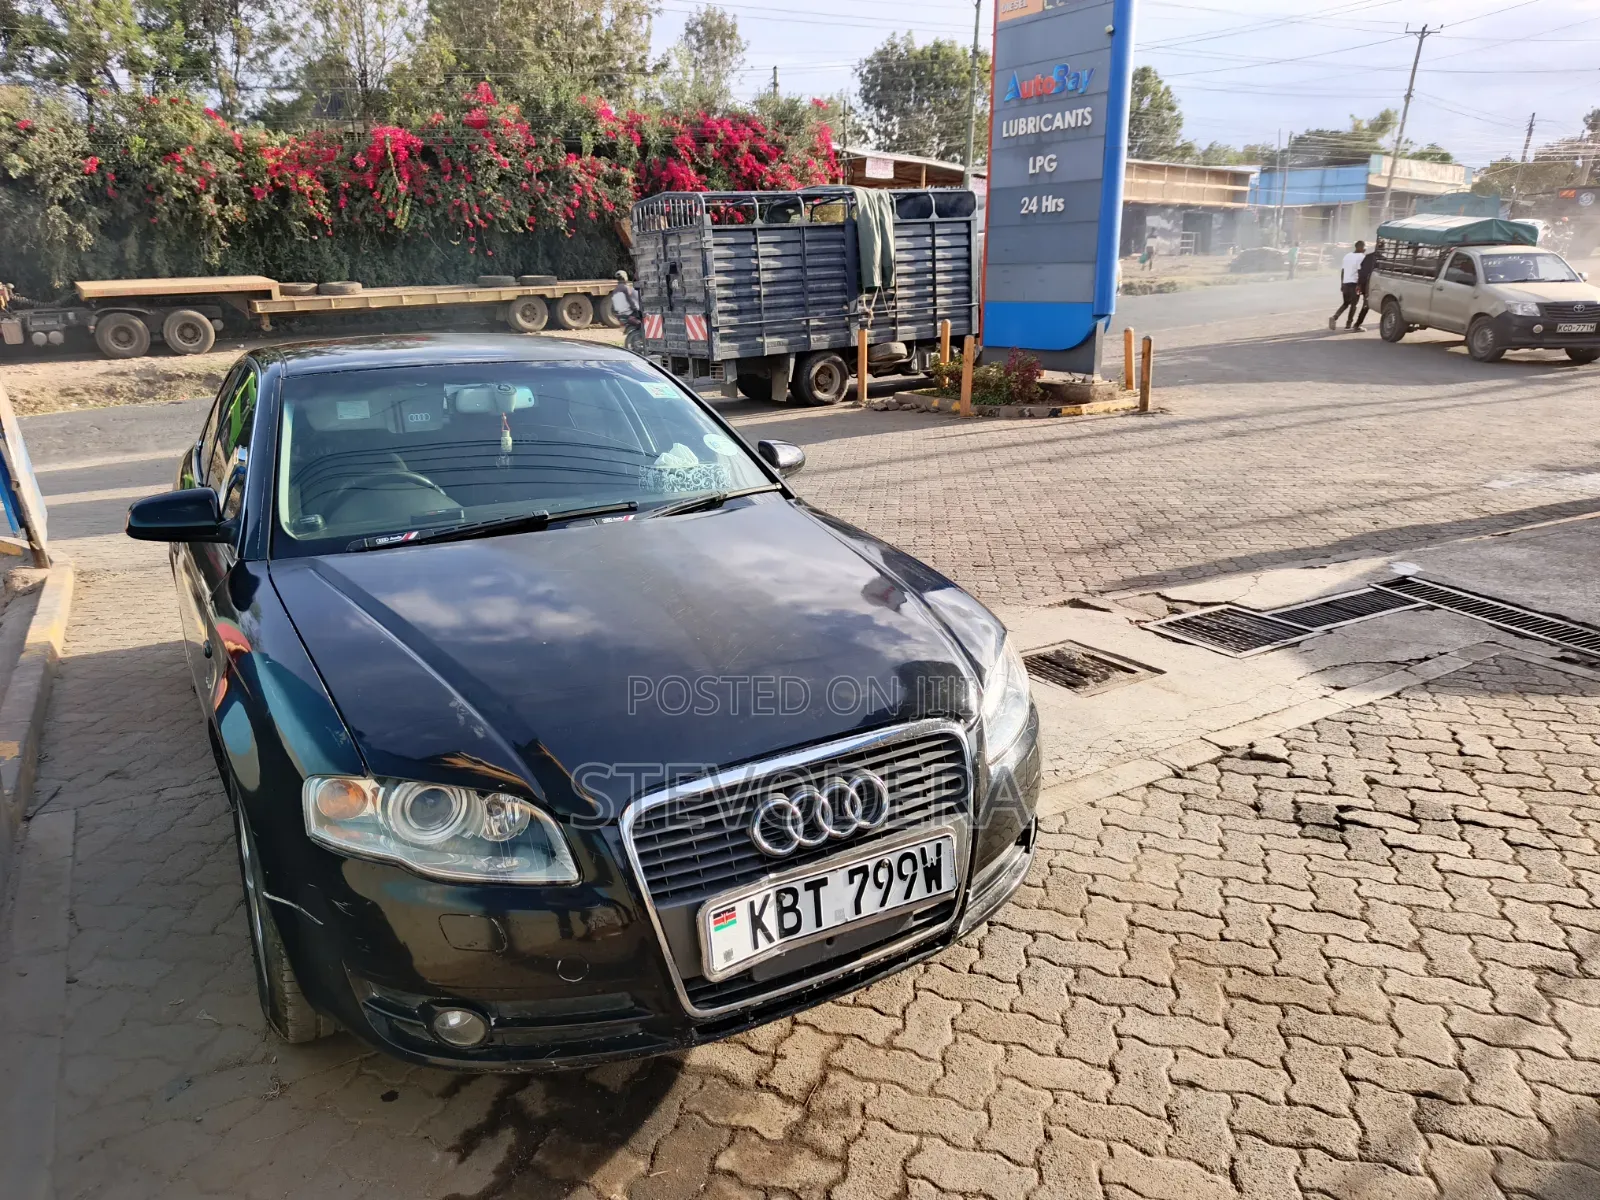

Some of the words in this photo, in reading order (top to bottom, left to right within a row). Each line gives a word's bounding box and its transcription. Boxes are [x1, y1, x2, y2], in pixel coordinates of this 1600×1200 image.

[1004, 63, 1096, 102] AutoBay
[1002, 107, 1092, 138] LUBRICANTS
[1028, 154, 1057, 174] LPG
[1020, 196, 1038, 214] 24
[1042, 195, 1064, 213] Hrs
[749, 877, 828, 950] KBT
[848, 842, 943, 916] 799W
